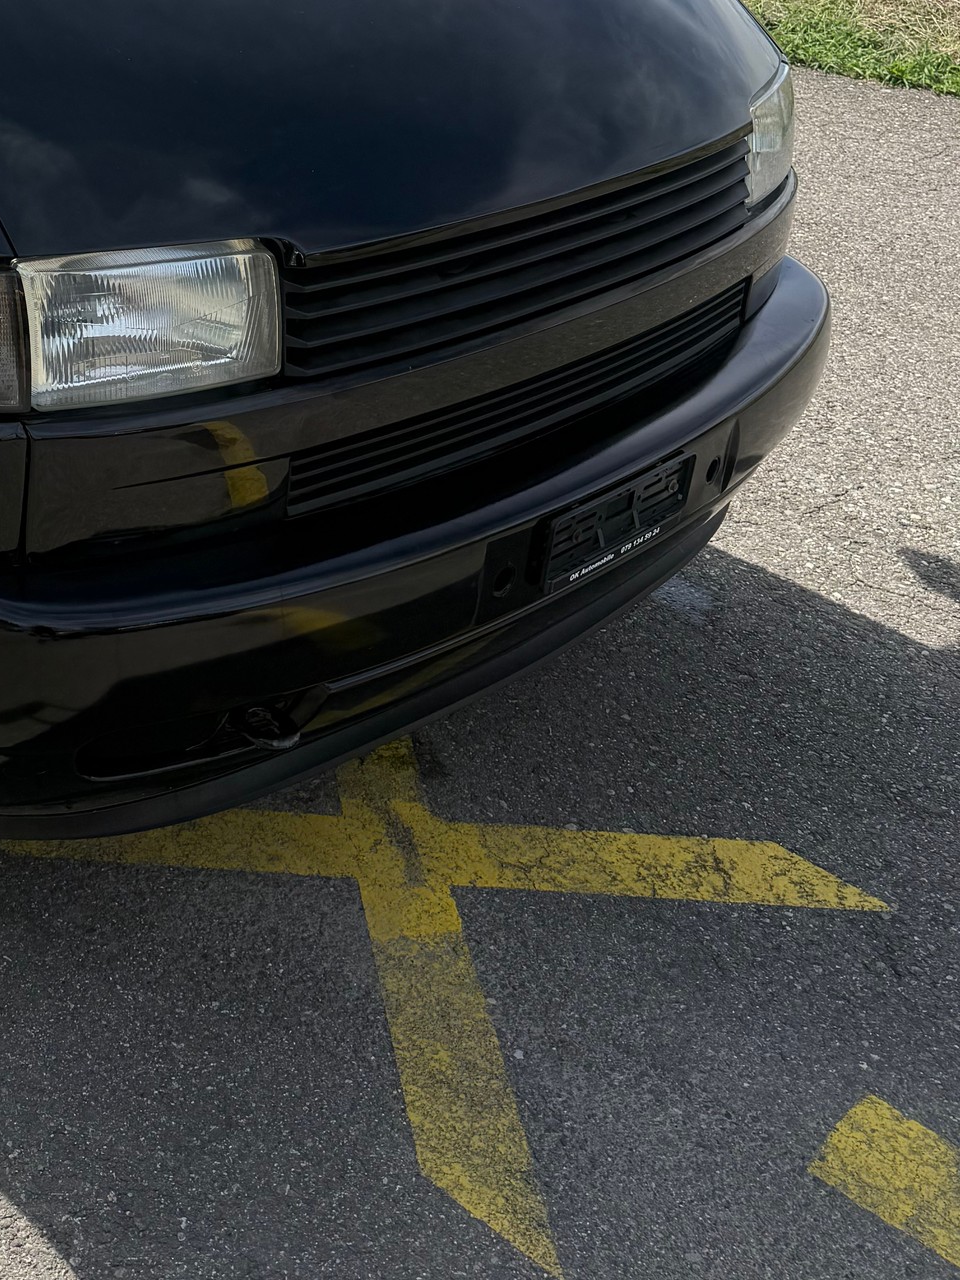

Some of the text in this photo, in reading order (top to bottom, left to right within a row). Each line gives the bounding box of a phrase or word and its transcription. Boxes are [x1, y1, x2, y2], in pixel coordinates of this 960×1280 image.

[569, 571, 580, 582] OK
[580, 553, 615, 576] Automobile
[620, 542, 632, 554] 079
[633, 536, 644, 547] 134
